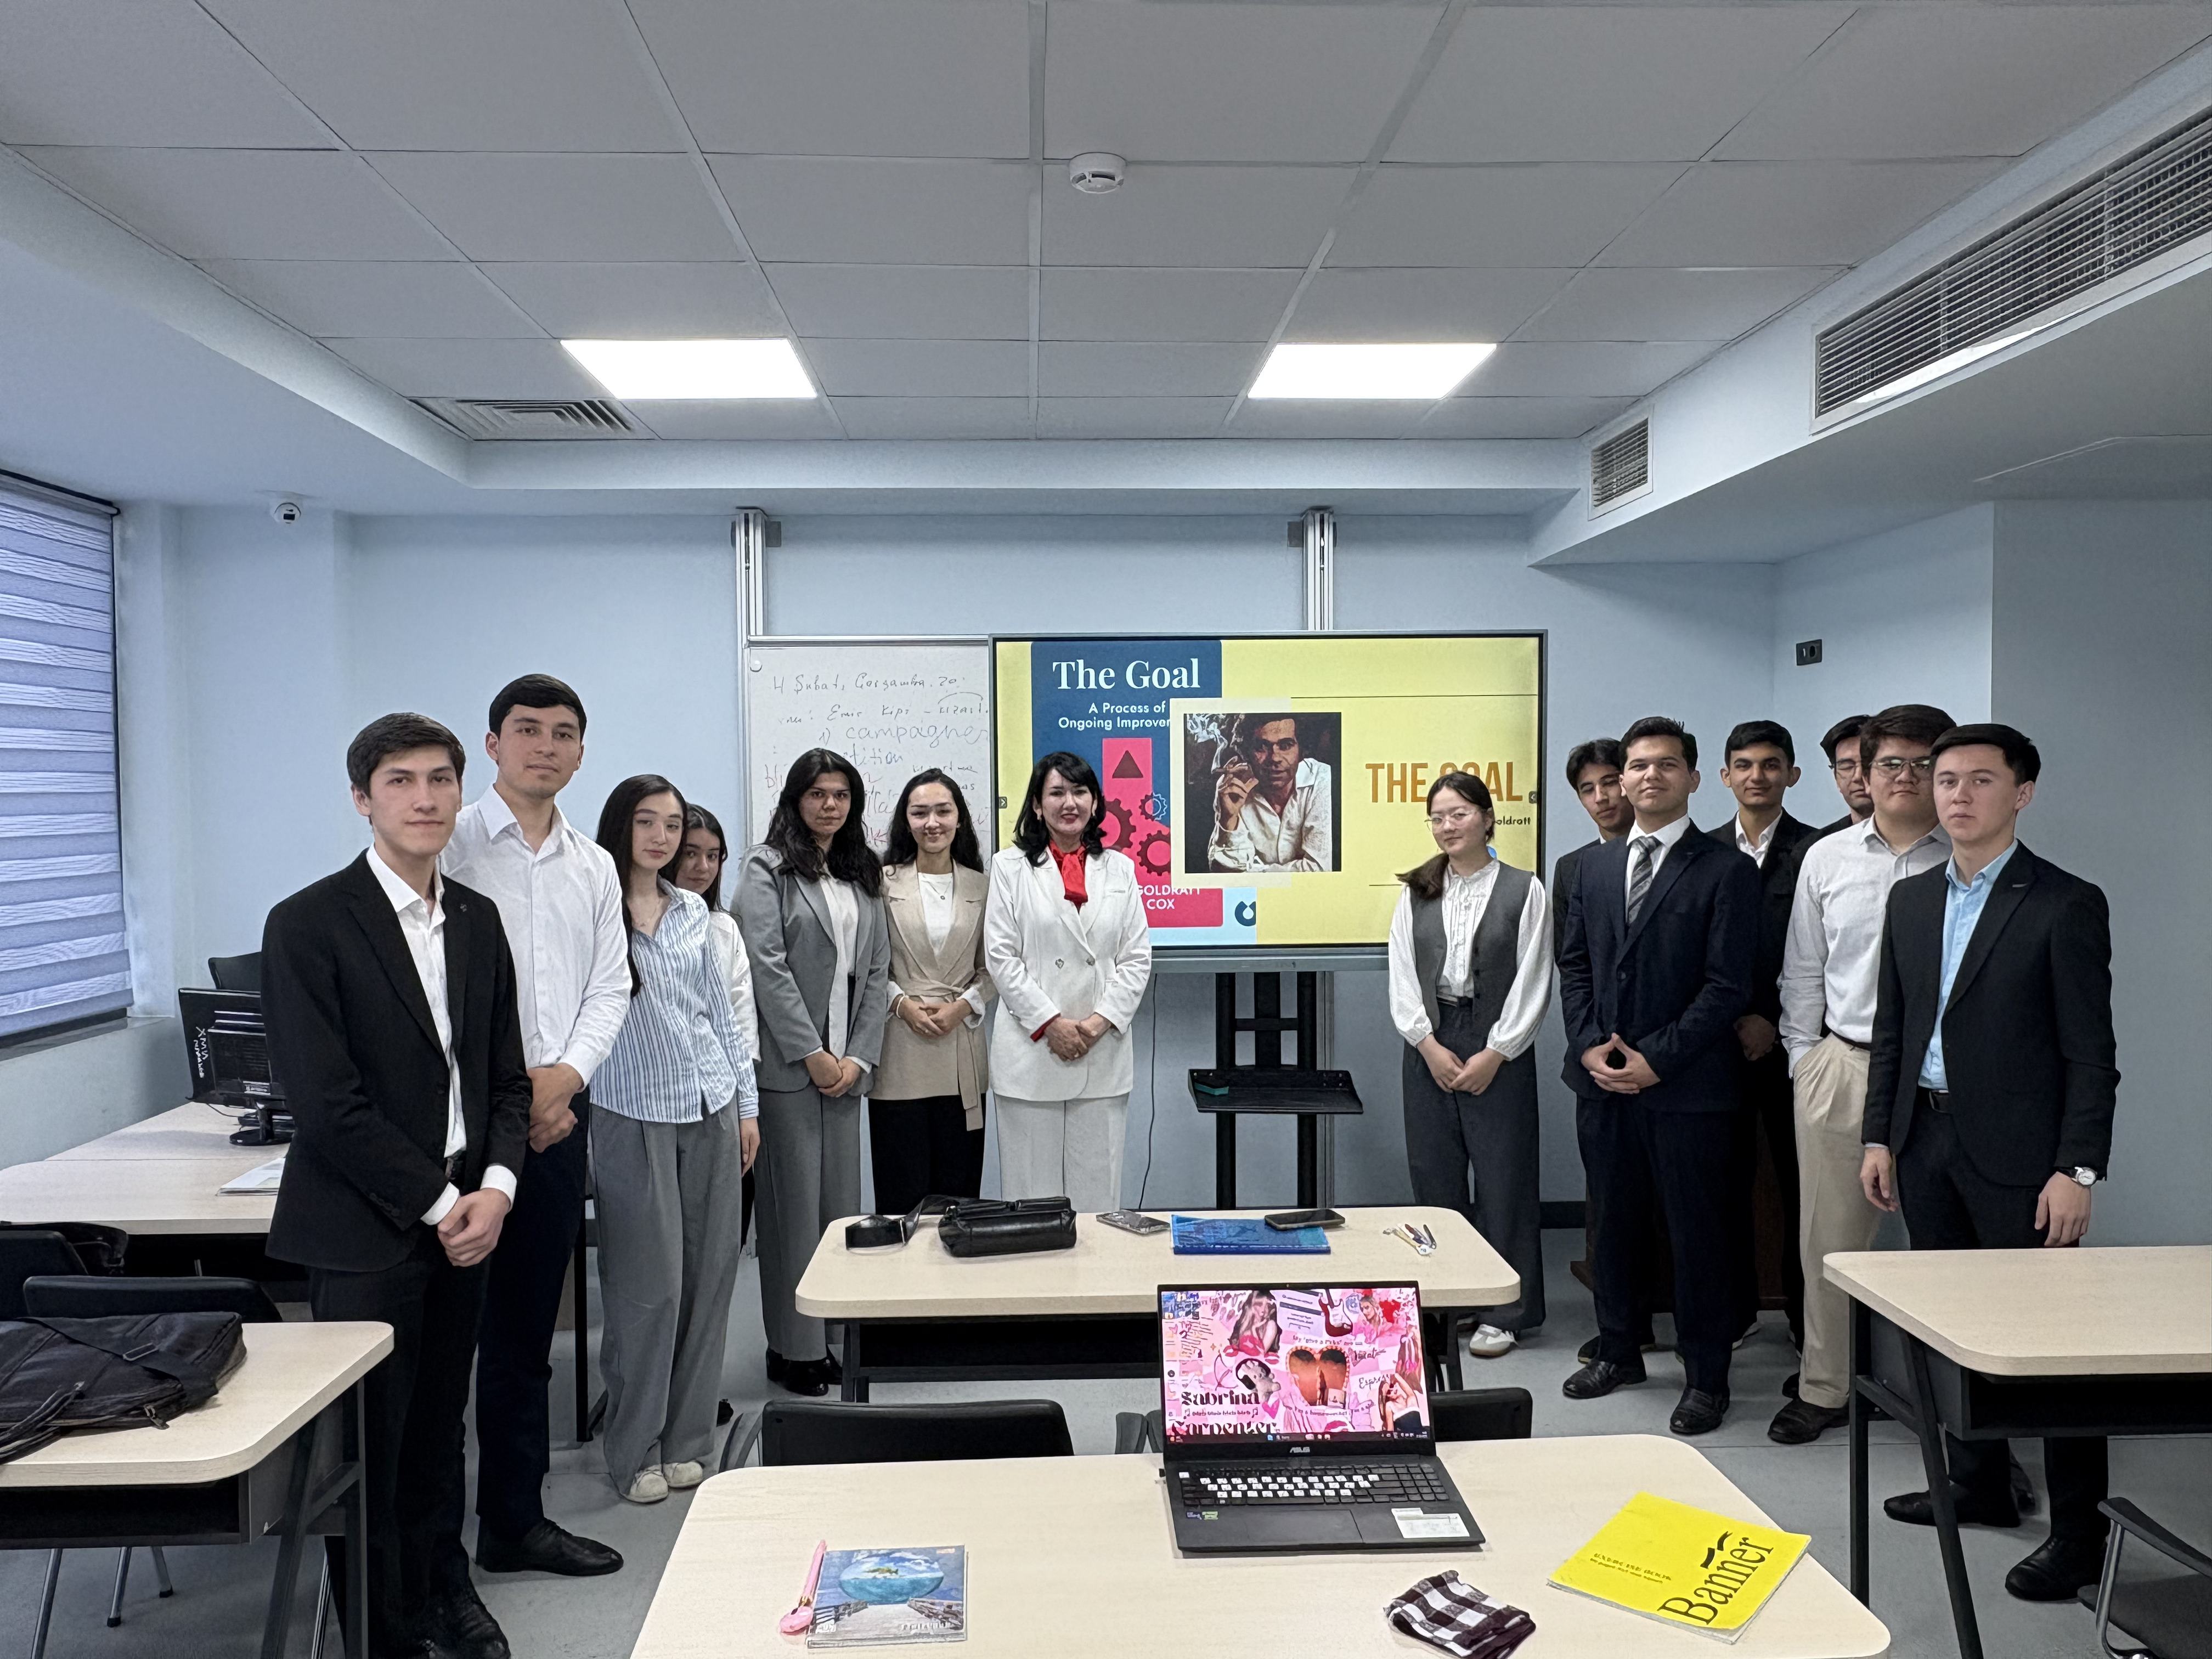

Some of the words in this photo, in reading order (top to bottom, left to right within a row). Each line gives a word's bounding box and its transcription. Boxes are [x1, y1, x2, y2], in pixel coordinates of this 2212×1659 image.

[1052, 659, 1116, 690] The
[1126, 658, 1201, 689] Goal
[1088, 702, 1098, 714] A
[1103, 702, 1149, 714] Process
[1153, 701, 1166, 713] of
[1058, 716, 1113, 731] Ongoing
[1365, 763, 1428, 803] THE
[1147, 899, 1175, 910] COX
[1181, 1390, 1261, 1406] Sabrina
[1657, 1537, 1774, 1625] Banner
